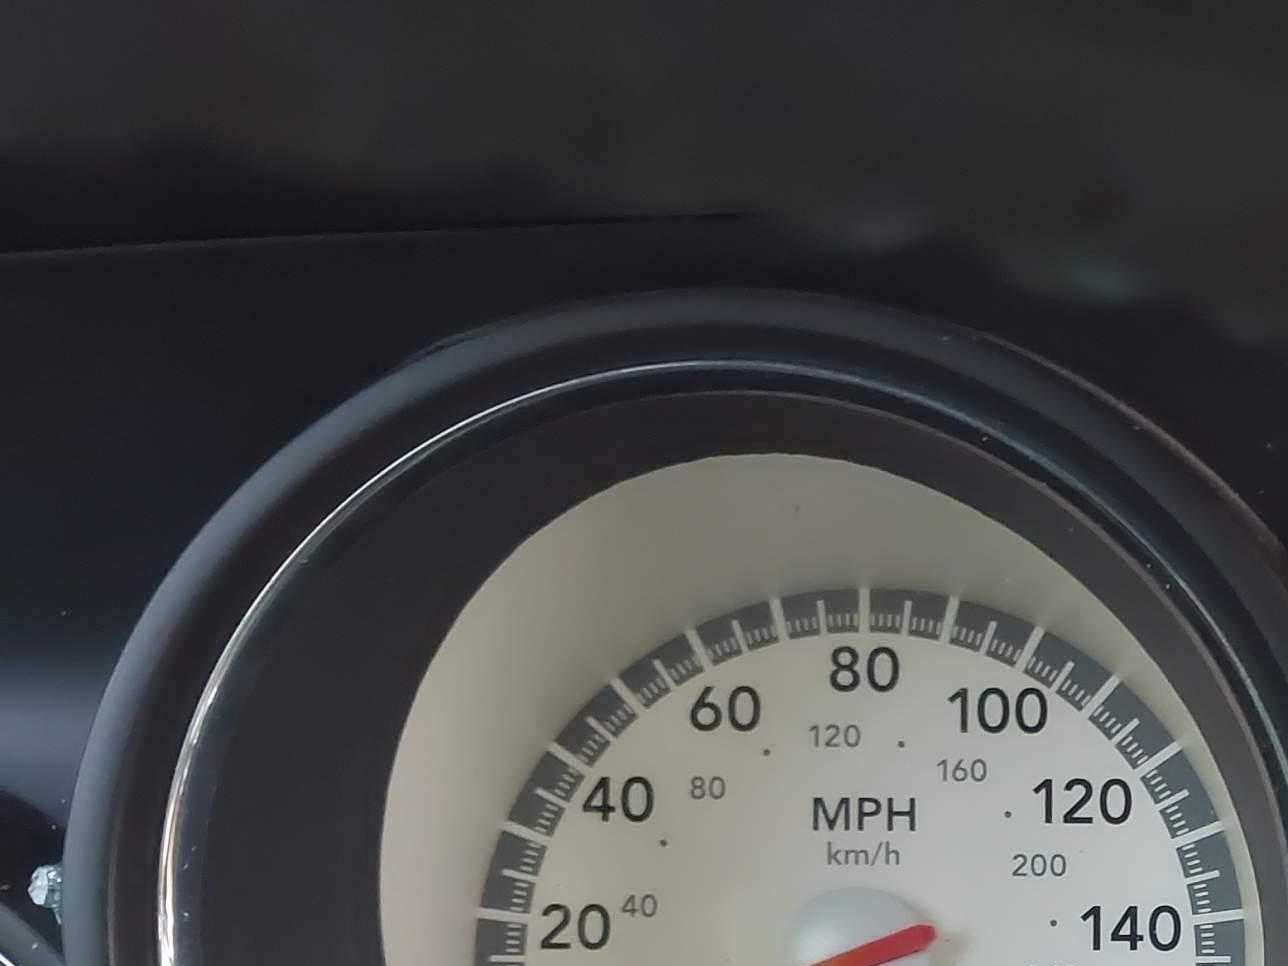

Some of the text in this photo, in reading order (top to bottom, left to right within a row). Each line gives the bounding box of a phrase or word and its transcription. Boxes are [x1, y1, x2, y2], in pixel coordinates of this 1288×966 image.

[829, 646, 900, 693] 80
[690, 686, 761, 731] 60
[948, 687, 1048, 734] 100
[808, 724, 861, 748] 120
[690, 776, 726, 800] 80
[936, 758, 987, 783] 160
[582, 776, 655, 822] 40
[812, 797, 917, 832] MPH
[1032, 778, 1132, 825] 120
[827, 841, 900, 867] km/h
[1011, 853, 1067, 877] 200
[621, 894, 658, 918] 40
[540, 903, 611, 950] 20
[1080, 905, 1182, 951] 140
